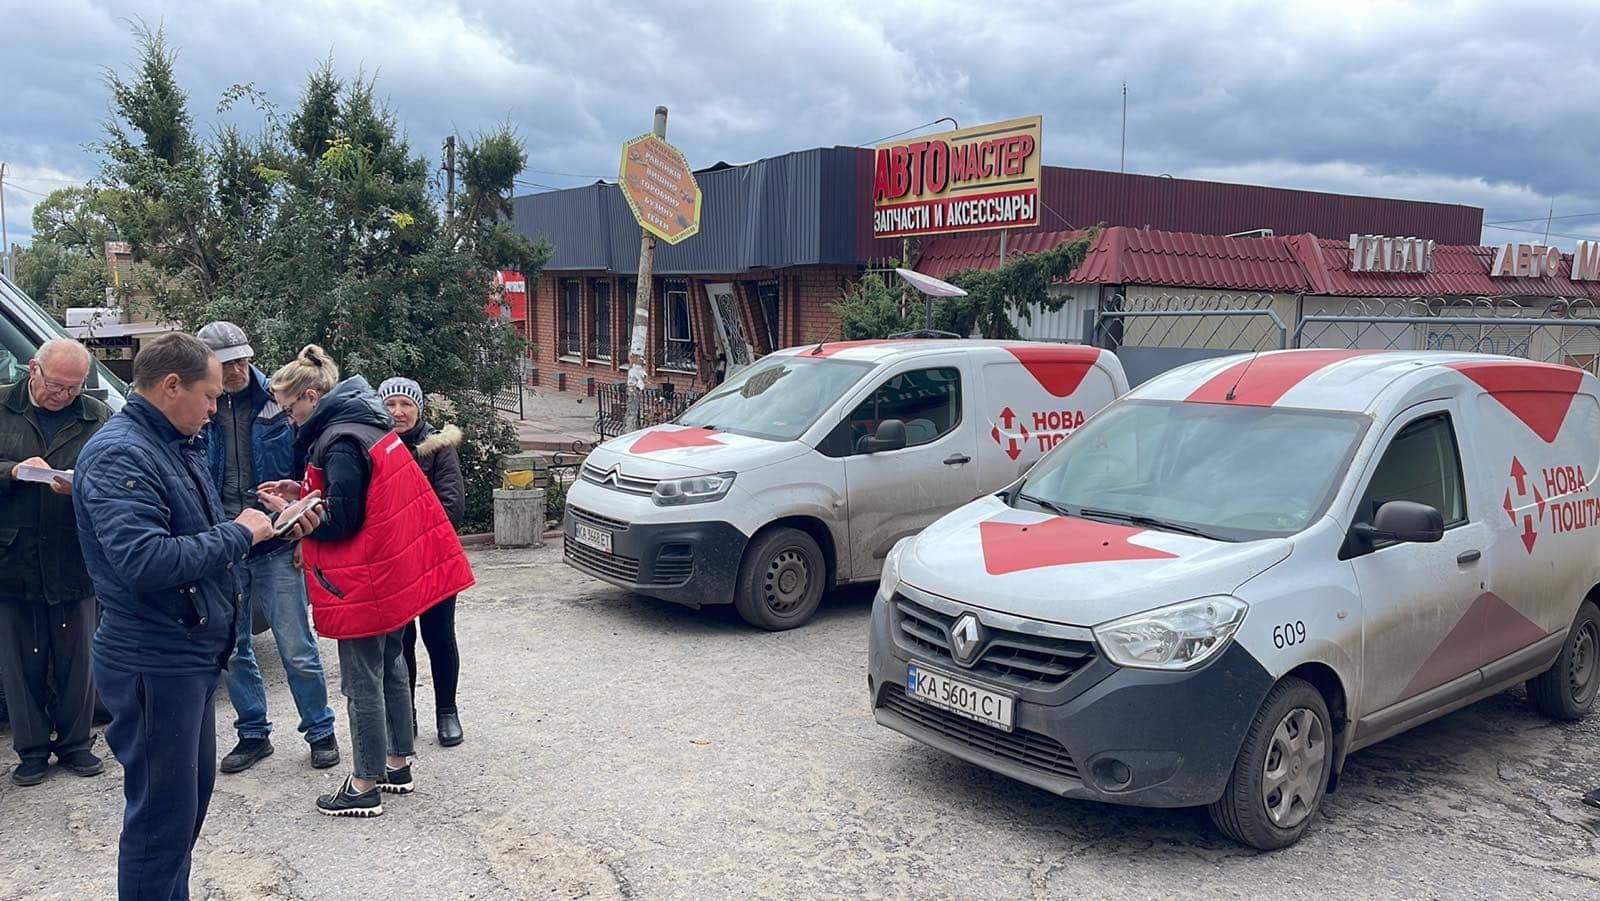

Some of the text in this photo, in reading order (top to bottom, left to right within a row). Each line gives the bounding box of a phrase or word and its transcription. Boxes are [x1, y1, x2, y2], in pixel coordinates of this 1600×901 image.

[873, 134, 1035, 201] АВТО МАСТЕР
[874, 194, 1035, 232] ЗАПЧАСТИ И АКСЕССУАРЫ
[1491, 241, 1561, 278] АВТО
[1032, 410, 1085, 430] НОВА
[1543, 465, 1590, 497] НОВА
[1273, 620, 1306, 649] 609
[916, 671, 938, 698] KA
[941, 681, 977, 712] 5601
[982, 695, 1002, 720] CI
